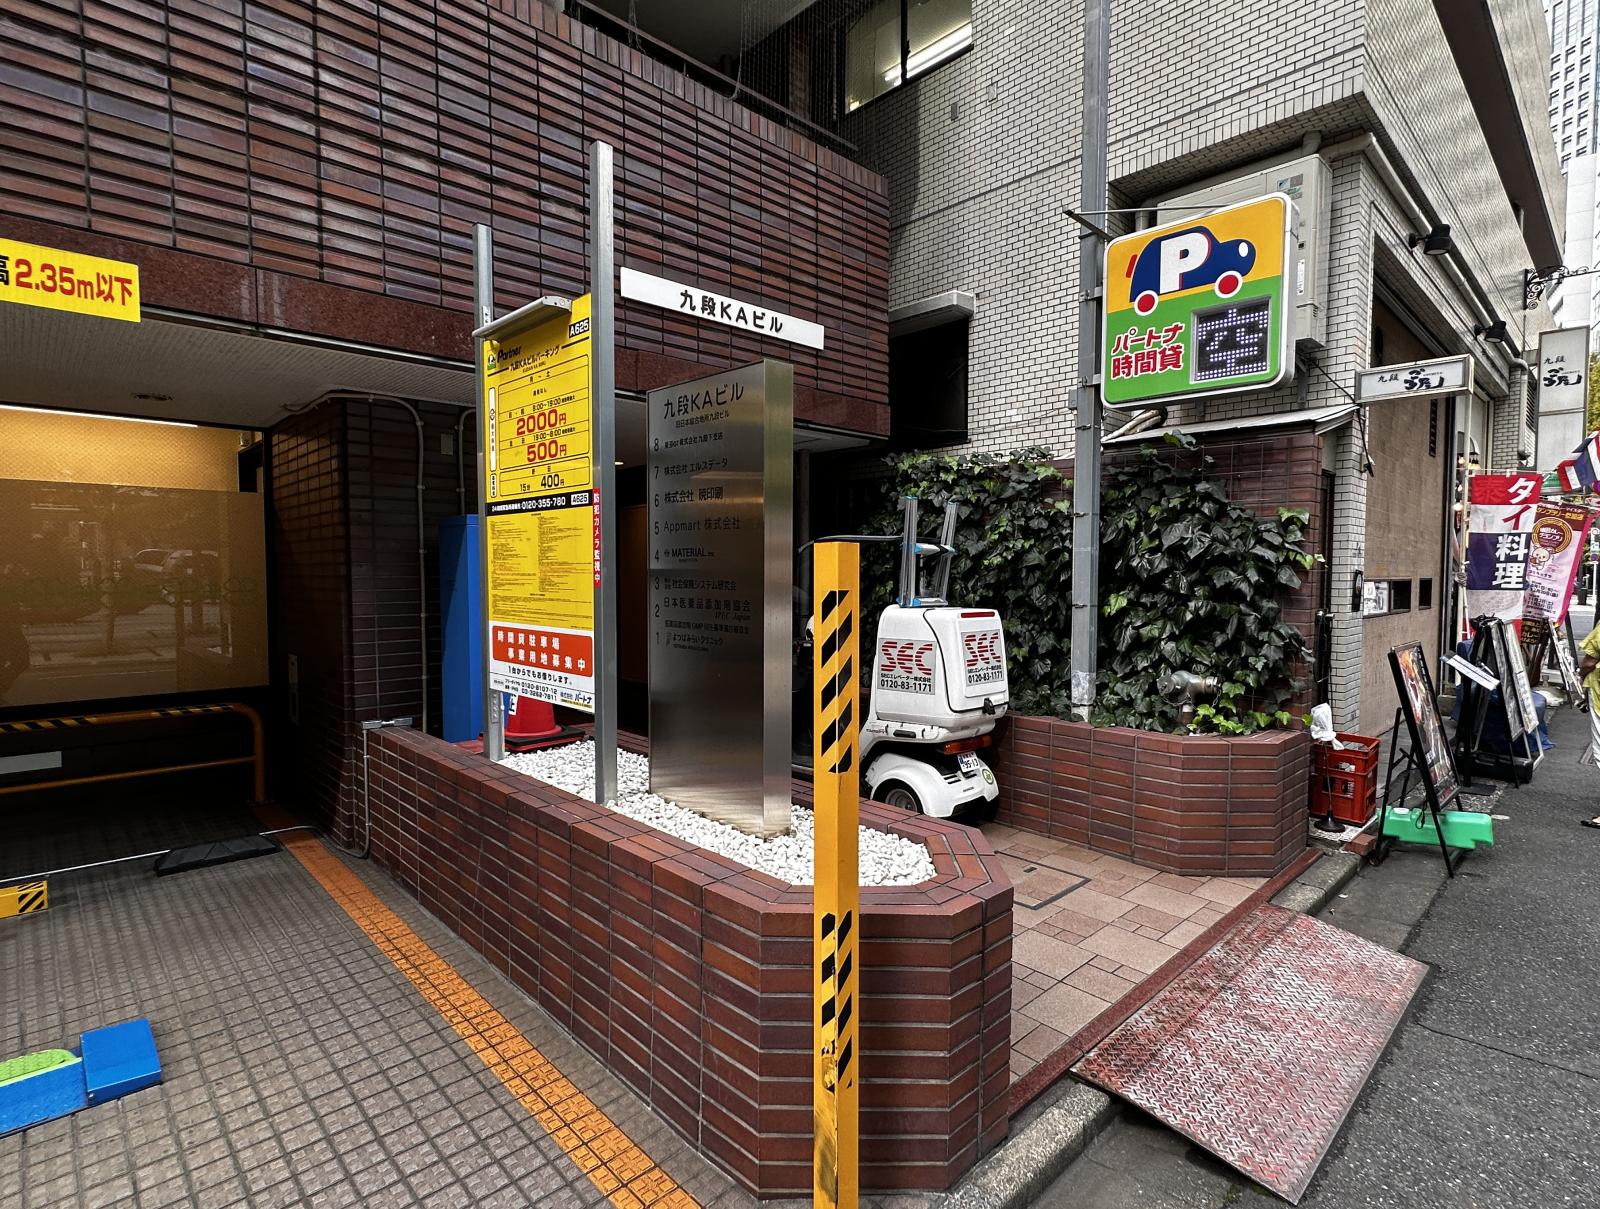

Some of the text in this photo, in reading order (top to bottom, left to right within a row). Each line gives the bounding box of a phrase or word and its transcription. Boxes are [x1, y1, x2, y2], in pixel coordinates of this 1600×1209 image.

[1160, 232, 1211, 294] P
[679, 289, 783, 333] 九段KAビル
[569, 319, 589, 336] A625
[1112, 321, 1184, 354] パートナ
[1112, 344, 1184, 379] 時間貸
[664, 382, 744, 420] 九段KAビル
[516, 408, 567, 436] 2000円
[526, 439, 567, 463] 500円
[653, 438, 659, 452] 8
[540, 474, 565, 488] 400円
[654, 465, 659, 479] 7
[664, 464, 688, 475] 株式会社
[654, 494, 659, 507] 6
[664, 489, 693, 504] 株式会社
[654, 516, 741, 535] 5 Appmart 株式会社
[1491, 477, 1537, 589] タイ料理
[593, 493, 601, 583] 防犯カメラ監視中
[654, 547, 705, 563] 4 MATERIAL
[654, 576, 660, 590] 3
[654, 604, 660, 617] 2
[497, 630, 560, 650] 時間貸駐車場
[656, 632, 660, 645] 1
[507, 647, 586, 671] 事業用地募集中
[881, 641, 933, 675] SEC
[964, 632, 1001, 667] SEC
[880, 680, 932, 693] 0120-83-1171
[967, 671, 1003, 684] 0120-83-1171
